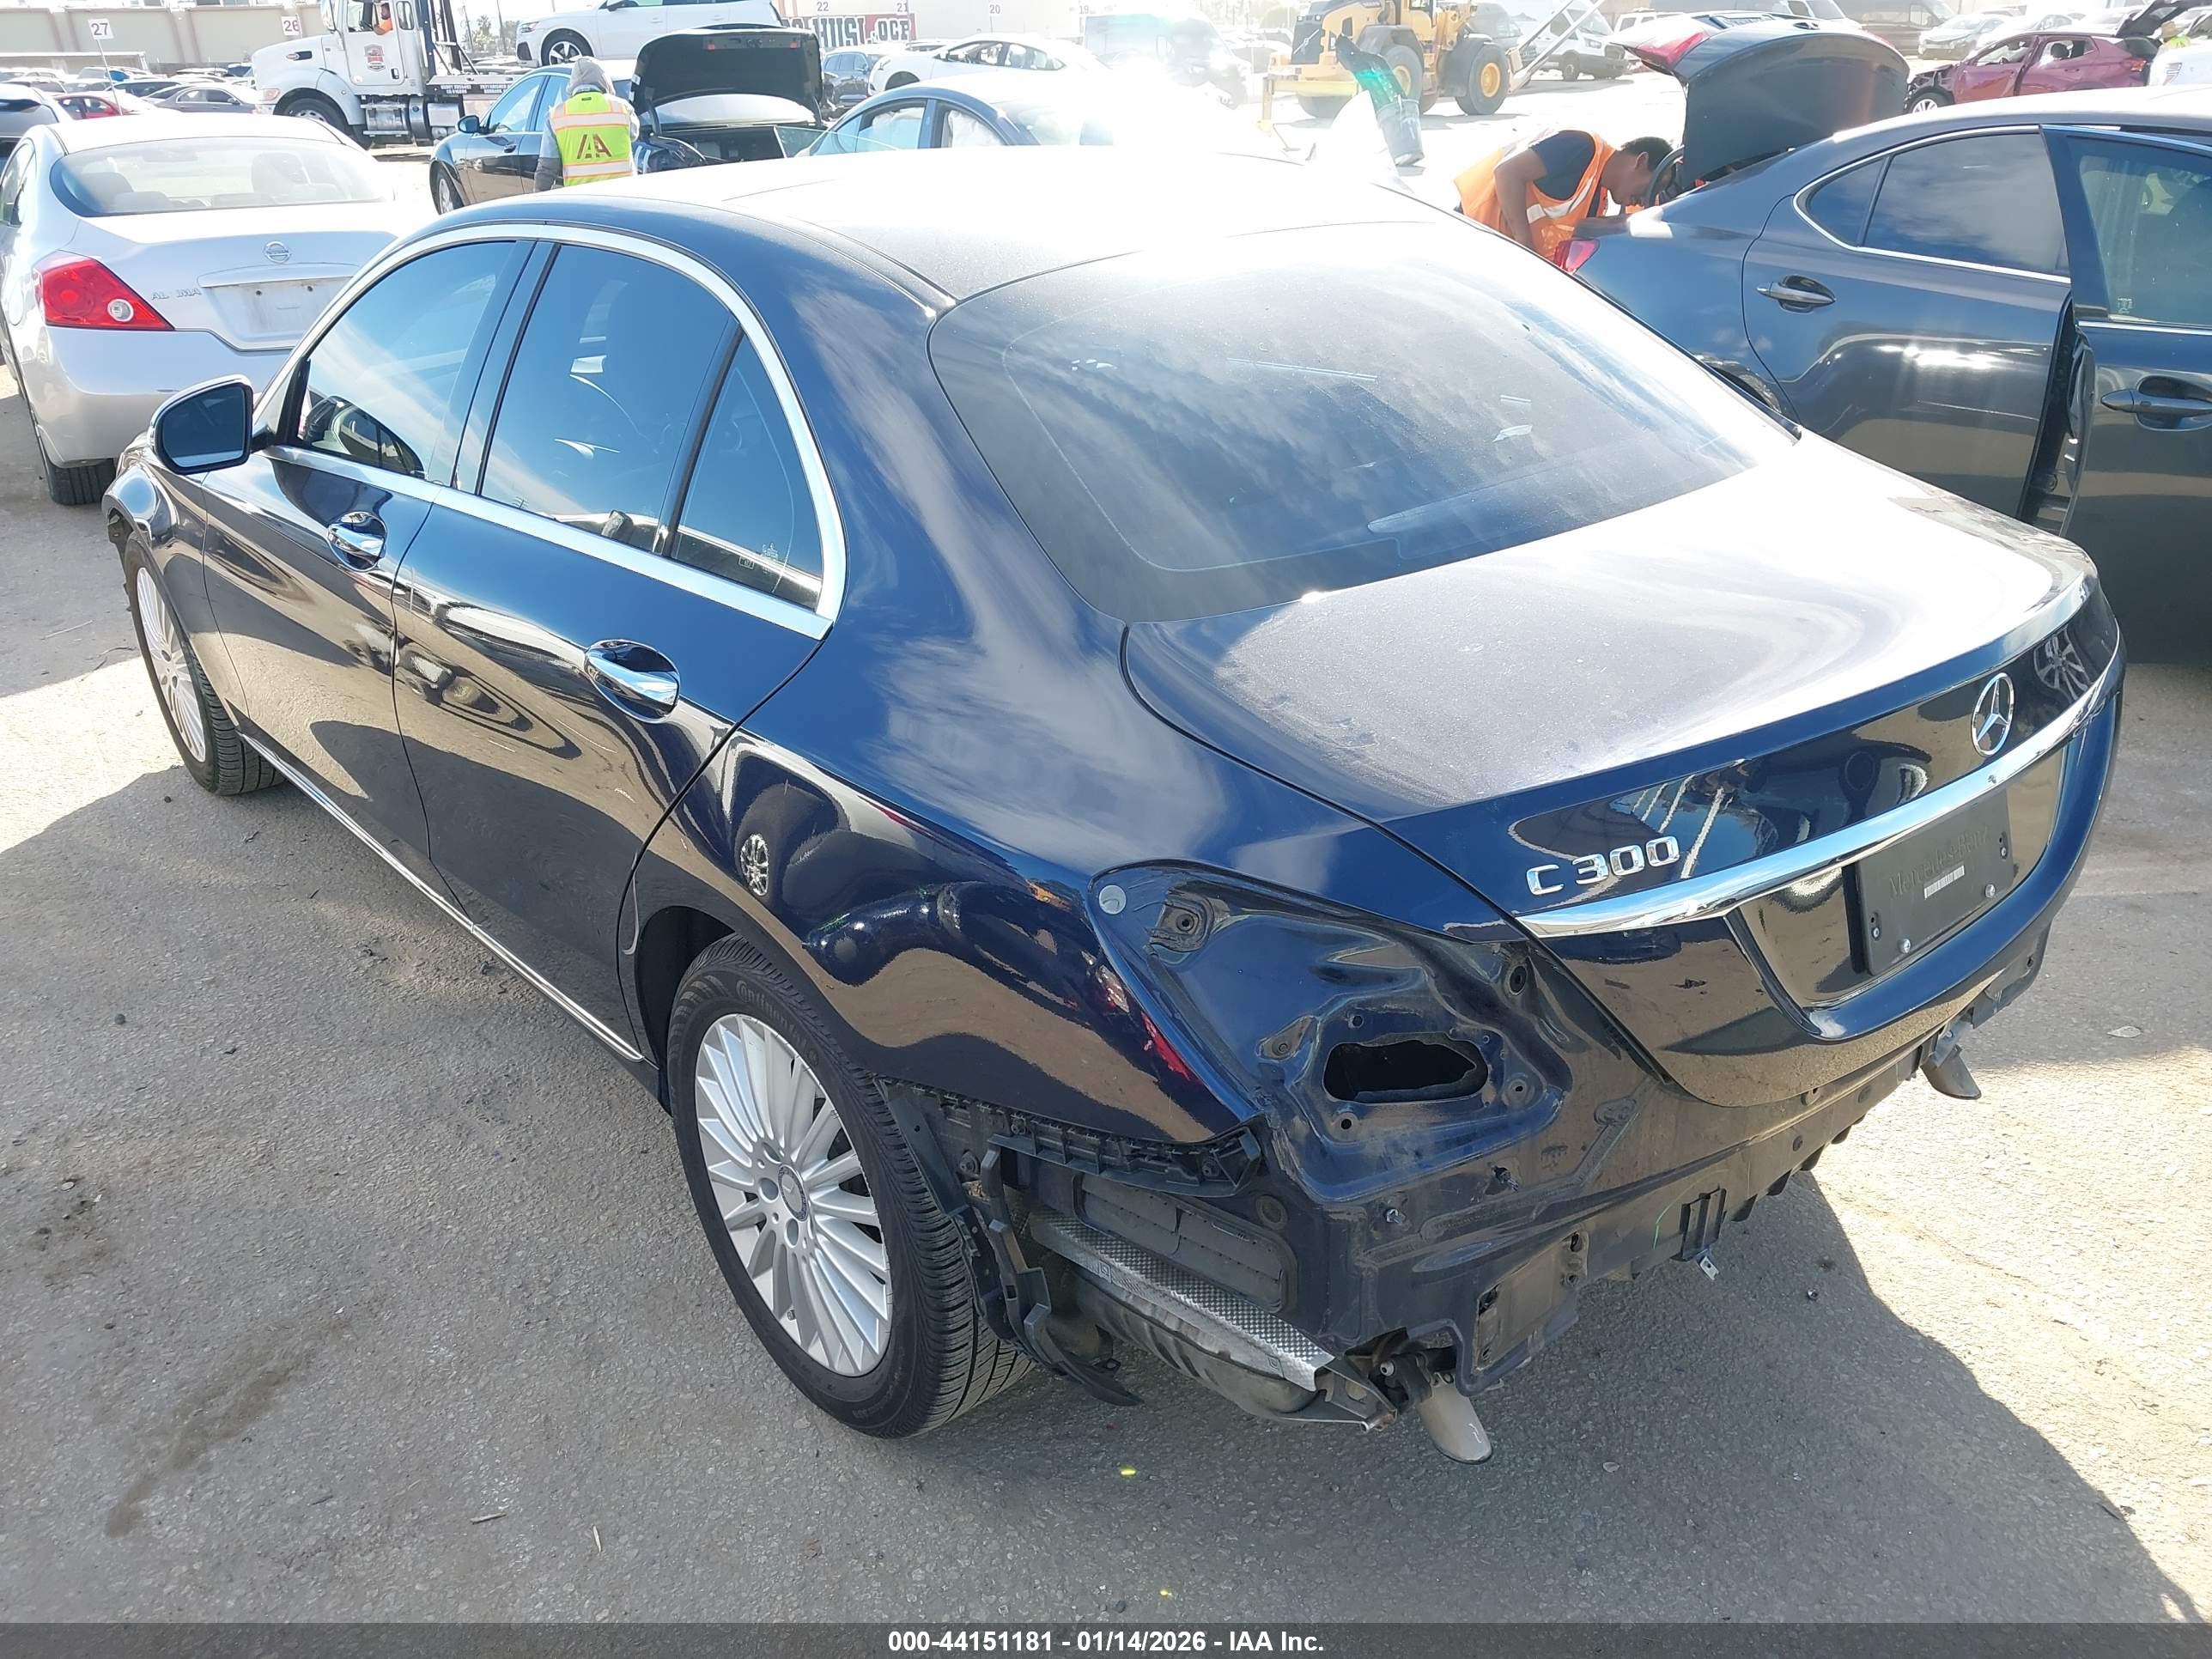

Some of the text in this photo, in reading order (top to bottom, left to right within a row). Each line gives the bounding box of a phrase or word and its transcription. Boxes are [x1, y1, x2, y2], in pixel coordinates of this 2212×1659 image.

[817, 2, 830, 12] 22
[896, 3, 908, 12] 21
[989, 4, 1001, 14] 20
[91, 22, 108, 35] 27
[283, 20, 300, 32] 26
[151, 289, 202, 301] ALIMA
[1526, 836, 1680, 896] C 300
